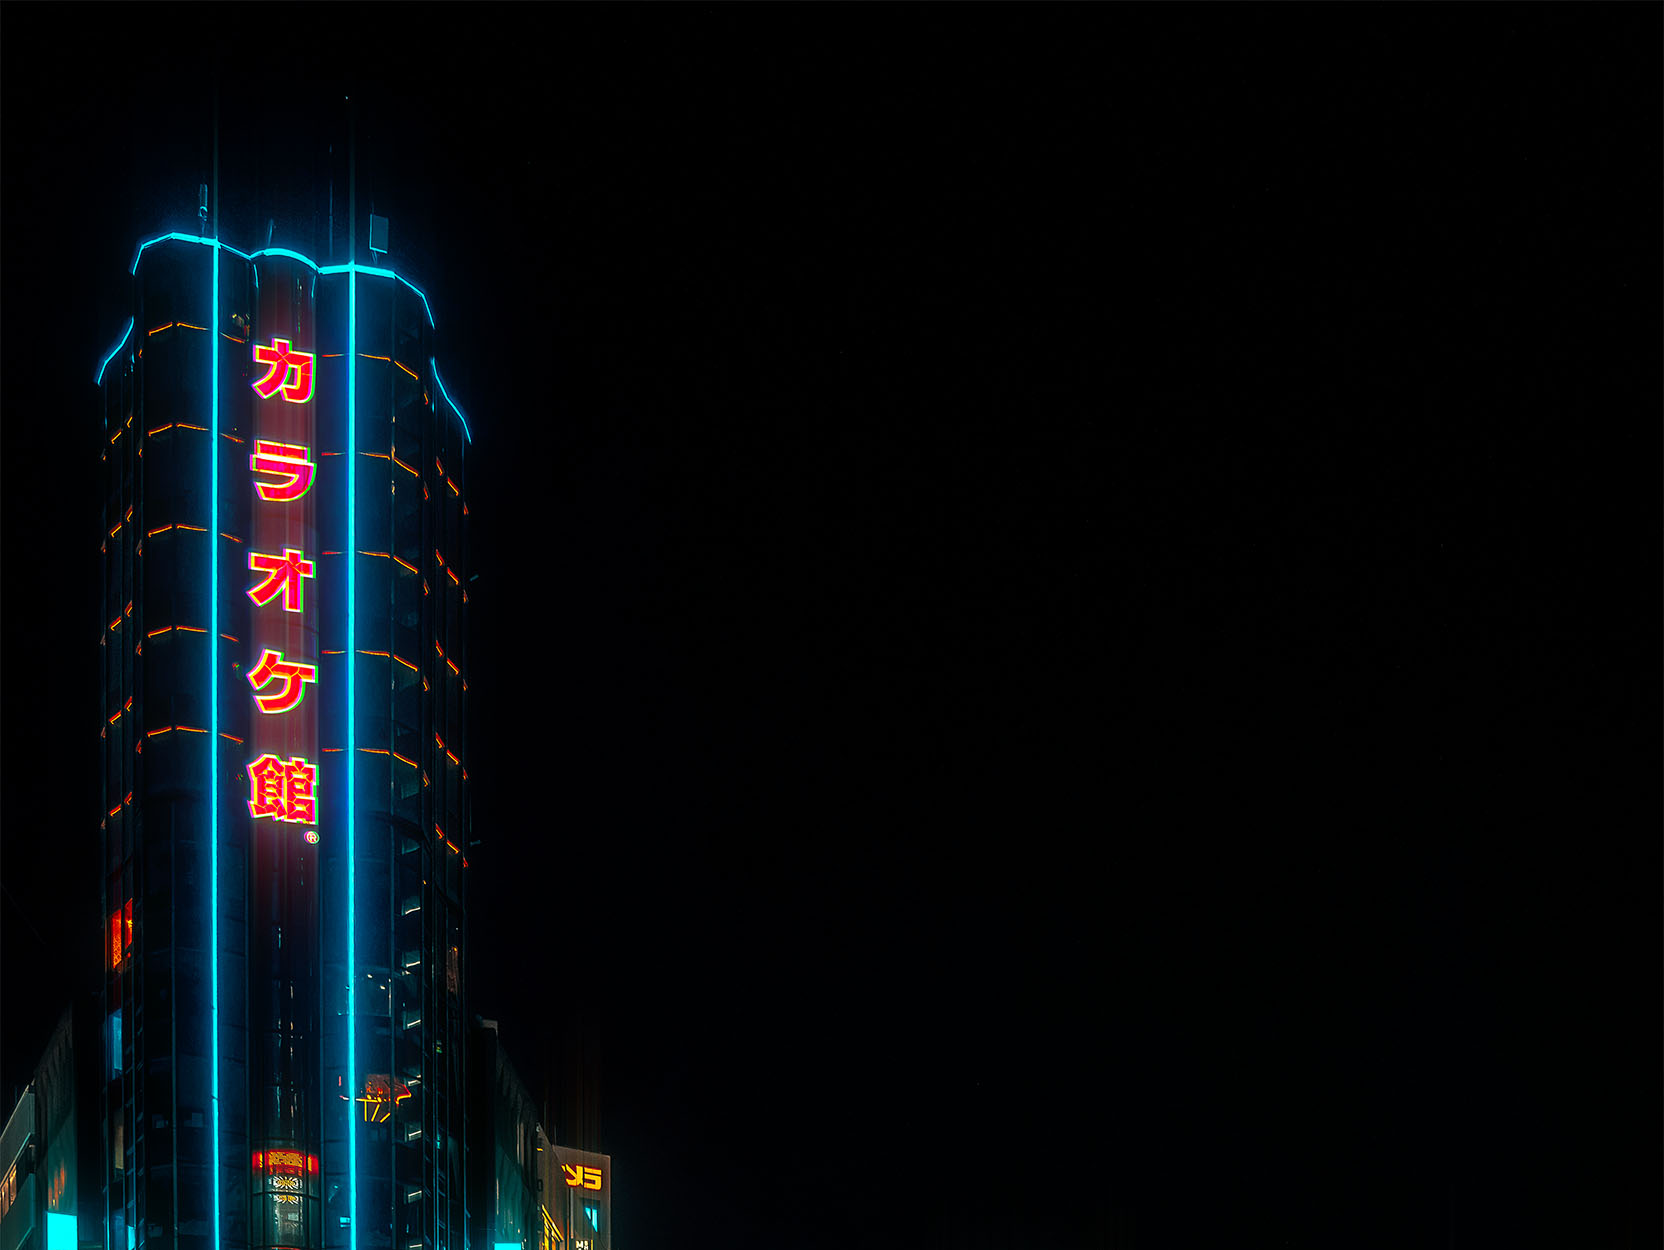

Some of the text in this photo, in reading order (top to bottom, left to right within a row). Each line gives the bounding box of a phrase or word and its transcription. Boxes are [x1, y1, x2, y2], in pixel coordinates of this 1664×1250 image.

[247, 338, 318, 824] カラオケ館
